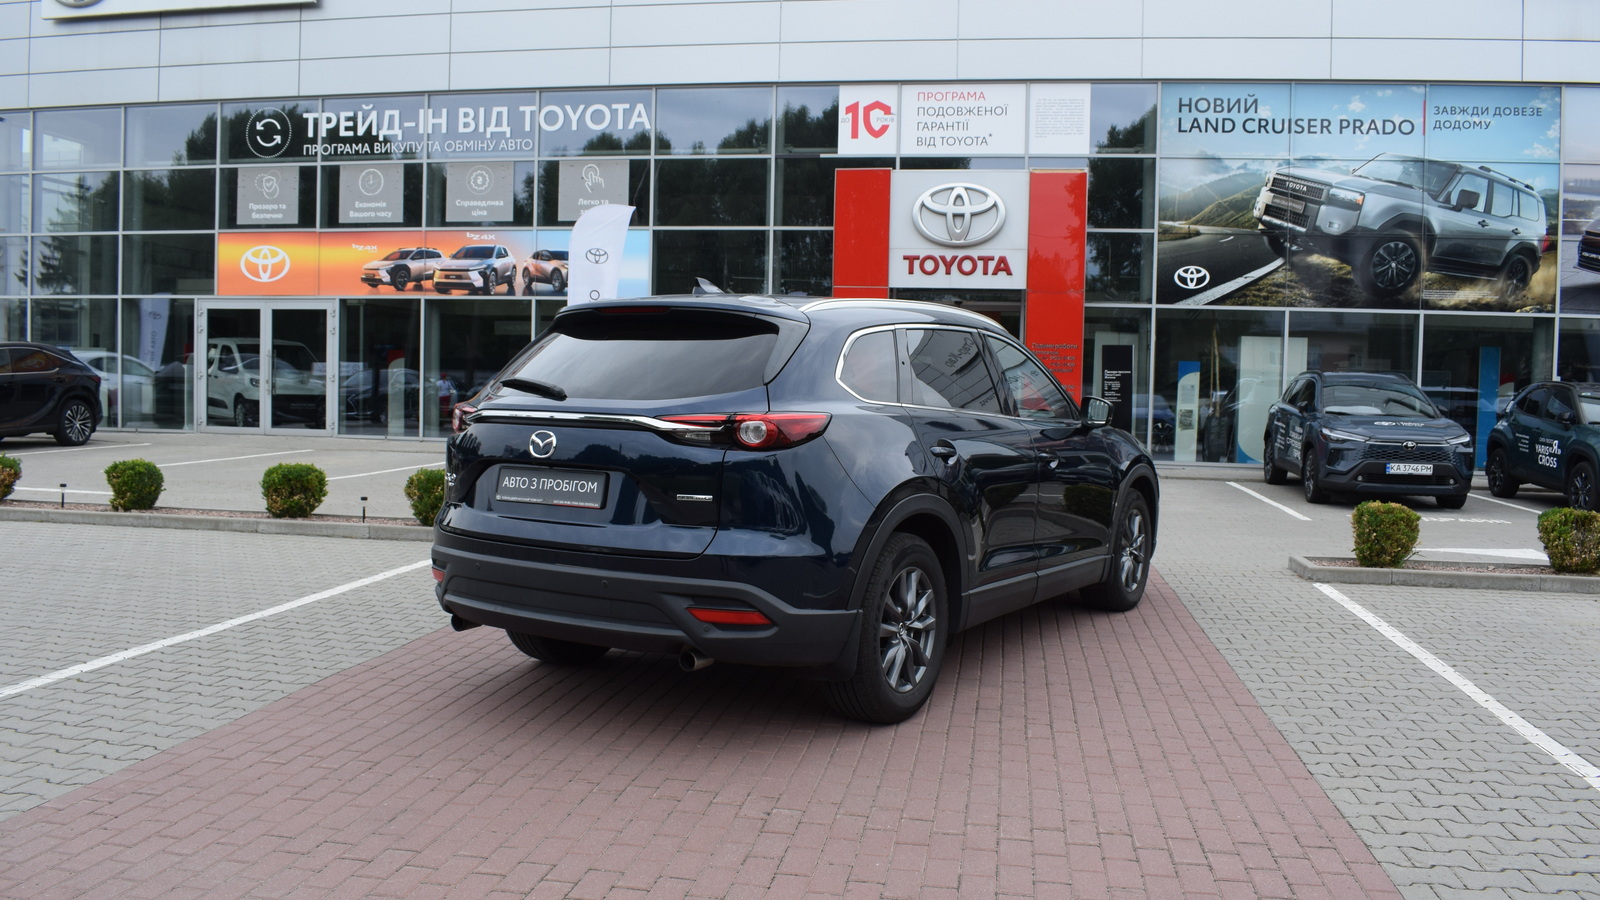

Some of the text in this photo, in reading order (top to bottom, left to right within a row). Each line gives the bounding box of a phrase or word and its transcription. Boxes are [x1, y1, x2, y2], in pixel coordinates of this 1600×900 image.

[917, 91, 986, 102] ПРОГРАМА
[1178, 93, 1259, 113] НОВИЙ
[917, 103, 1009, 118] ПОДОВЖЕНОЇ
[1433, 105, 1543, 118] ЗАВЖДИ ДОВЕЗЕ
[302, 103, 652, 141] ТРЕЙД-ІН ВІД TOYOTA
[916, 119, 970, 132] ГАРАНТІЇ
[1178, 117, 1415, 135] LAND CRUISER PRADO
[1432, 120, 1492, 131] ДОДОМУ
[302, 138, 533, 156] ПРОГРАМА ВИКУПУ ТА ОБМІНУ АВТО
[916, 136, 936, 148] ВІД
[1285, 181, 1307, 192] TOYOTA
[248, 203, 278, 211] Прозоро
[455, 199, 504, 207] Справедлива
[577, 198, 599, 206] Легко
[349, 210, 375, 218] Вашого
[902, 254, 1014, 276] TOYOTA
[1535, 444, 1549, 455] YARIS
[1538, 454, 1557, 468] CROSS
[1390, 464, 1432, 473] KA 3746 PM
[502, 476, 598, 494] АВТО З ПРОБІГОМ
